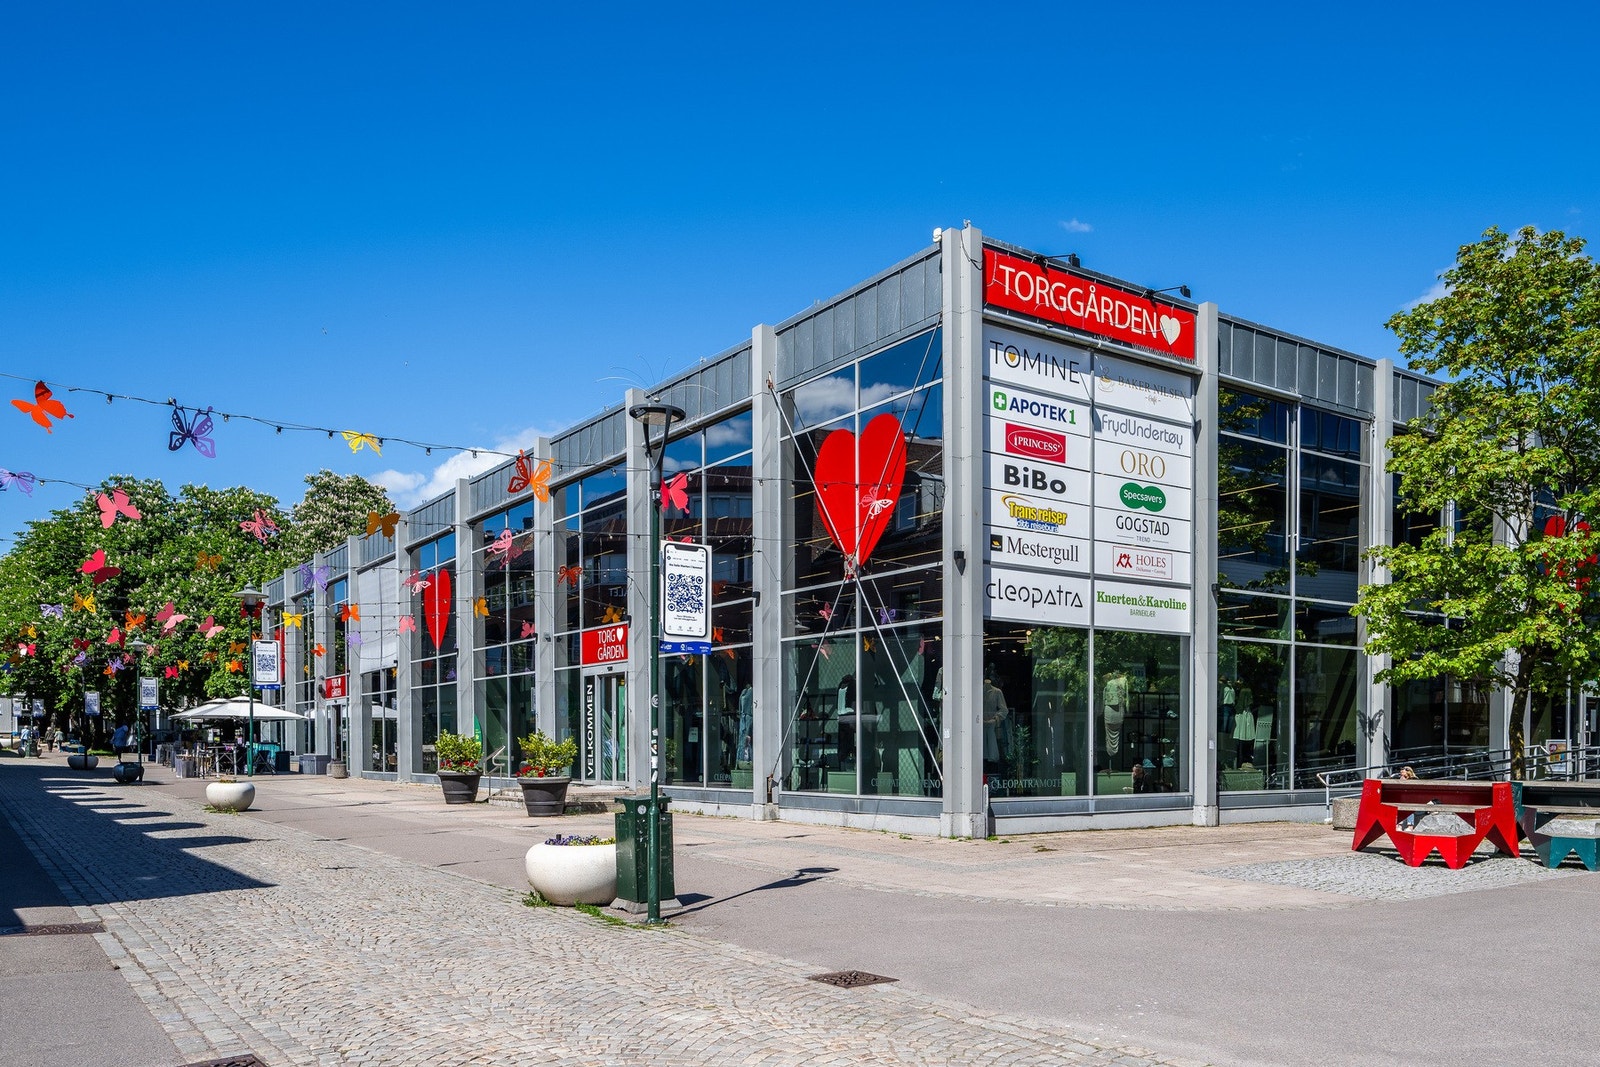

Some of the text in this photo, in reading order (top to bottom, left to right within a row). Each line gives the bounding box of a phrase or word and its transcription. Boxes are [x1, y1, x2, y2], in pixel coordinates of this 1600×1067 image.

[999, 265, 1157, 339] TORGGÅRDEN
[990, 340, 1080, 384] TOMINE
[1118, 375, 1187, 401] BAKER NILSEN
[1120, 449, 1166, 480] ORO
[1004, 464, 1067, 494] BiBo
[1123, 489, 1163, 505] Specsavers
[1116, 515, 1170, 536] GOGSTAD
[1136, 535, 1151, 543] TREND
[1006, 535, 1079, 565] Mestergull
[1136, 554, 1167, 569] HOLES
[1097, 590, 1187, 611] Knerten&Karoline
[598, 628, 616, 644] TORG
[597, 644, 625, 661] GÅRDEN
